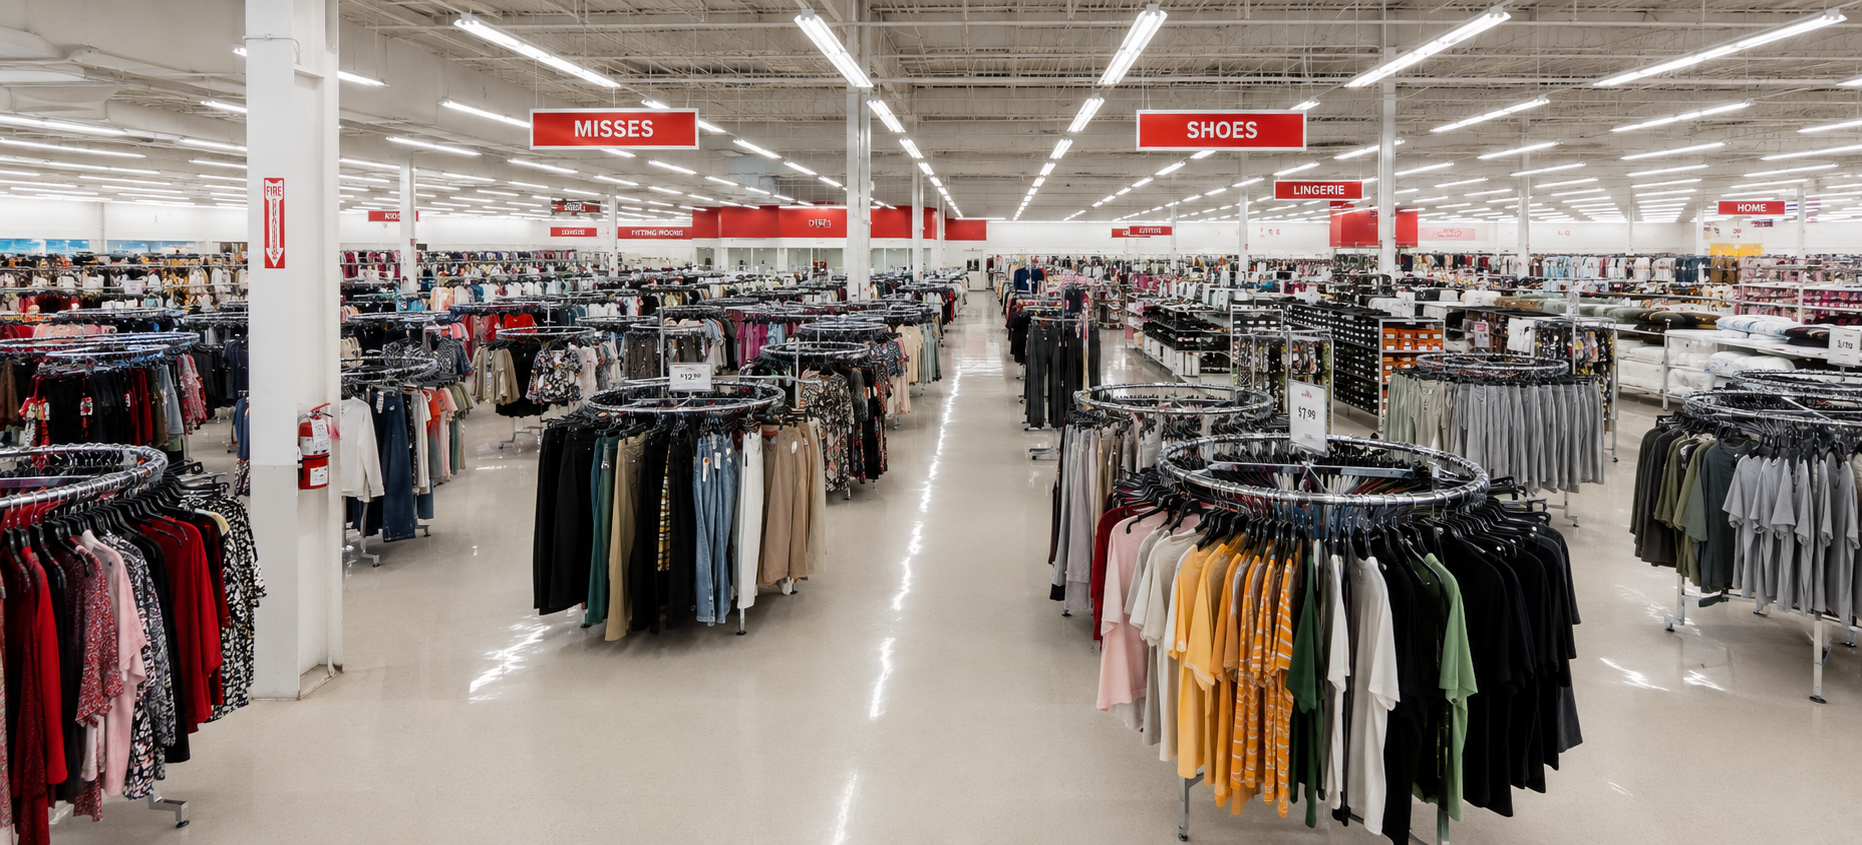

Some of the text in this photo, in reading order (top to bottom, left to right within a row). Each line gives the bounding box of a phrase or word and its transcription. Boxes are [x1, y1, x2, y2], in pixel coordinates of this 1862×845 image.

[574, 119, 654, 138] MISSES
[1186, 120, 1258, 139] SHOES
[266, 186, 282, 197] FIRE
[1293, 184, 1345, 196] LINGERIE
[1737, 203, 1767, 213] HOME
